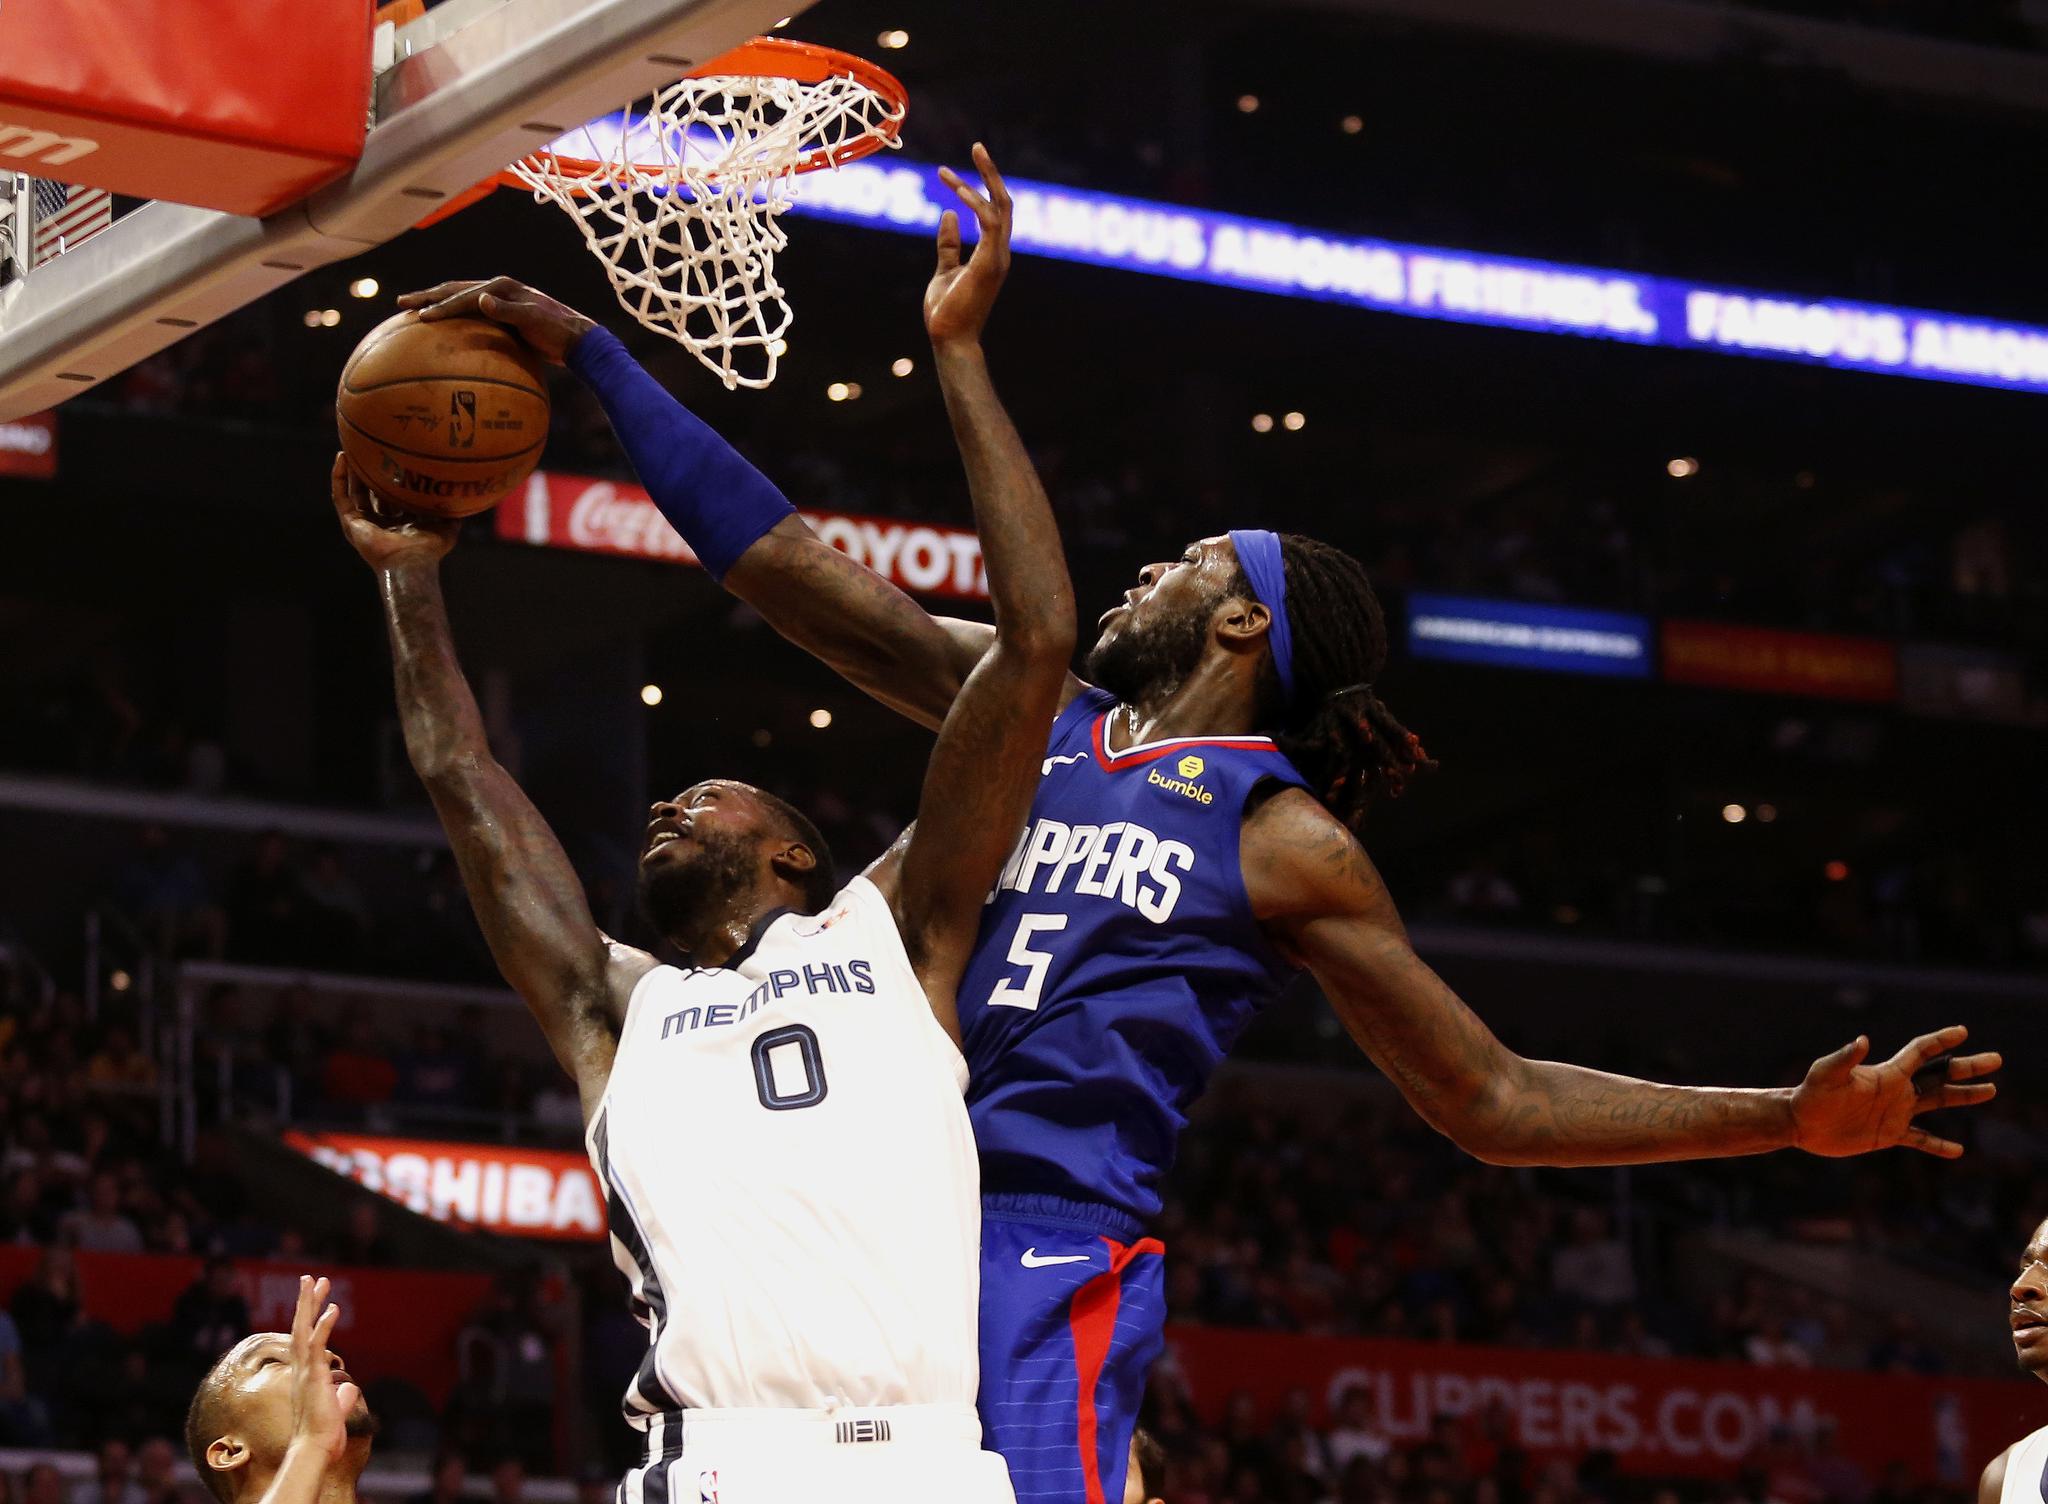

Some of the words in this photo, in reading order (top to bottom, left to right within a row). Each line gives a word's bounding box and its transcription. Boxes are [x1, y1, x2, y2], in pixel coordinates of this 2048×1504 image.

[976, 184, 1205, 270] AMOUS
[1687, 290, 1908, 365] FAMOUS
[800, 512, 989, 596] OYOT
[1148, 769, 1214, 805] bumble
[985, 818, 1195, 925] IPPERS
[660, 959, 876, 1041] MEMPHIS
[987, 913, 1069, 1011] 5
[751, 1023, 829, 1112] 0
